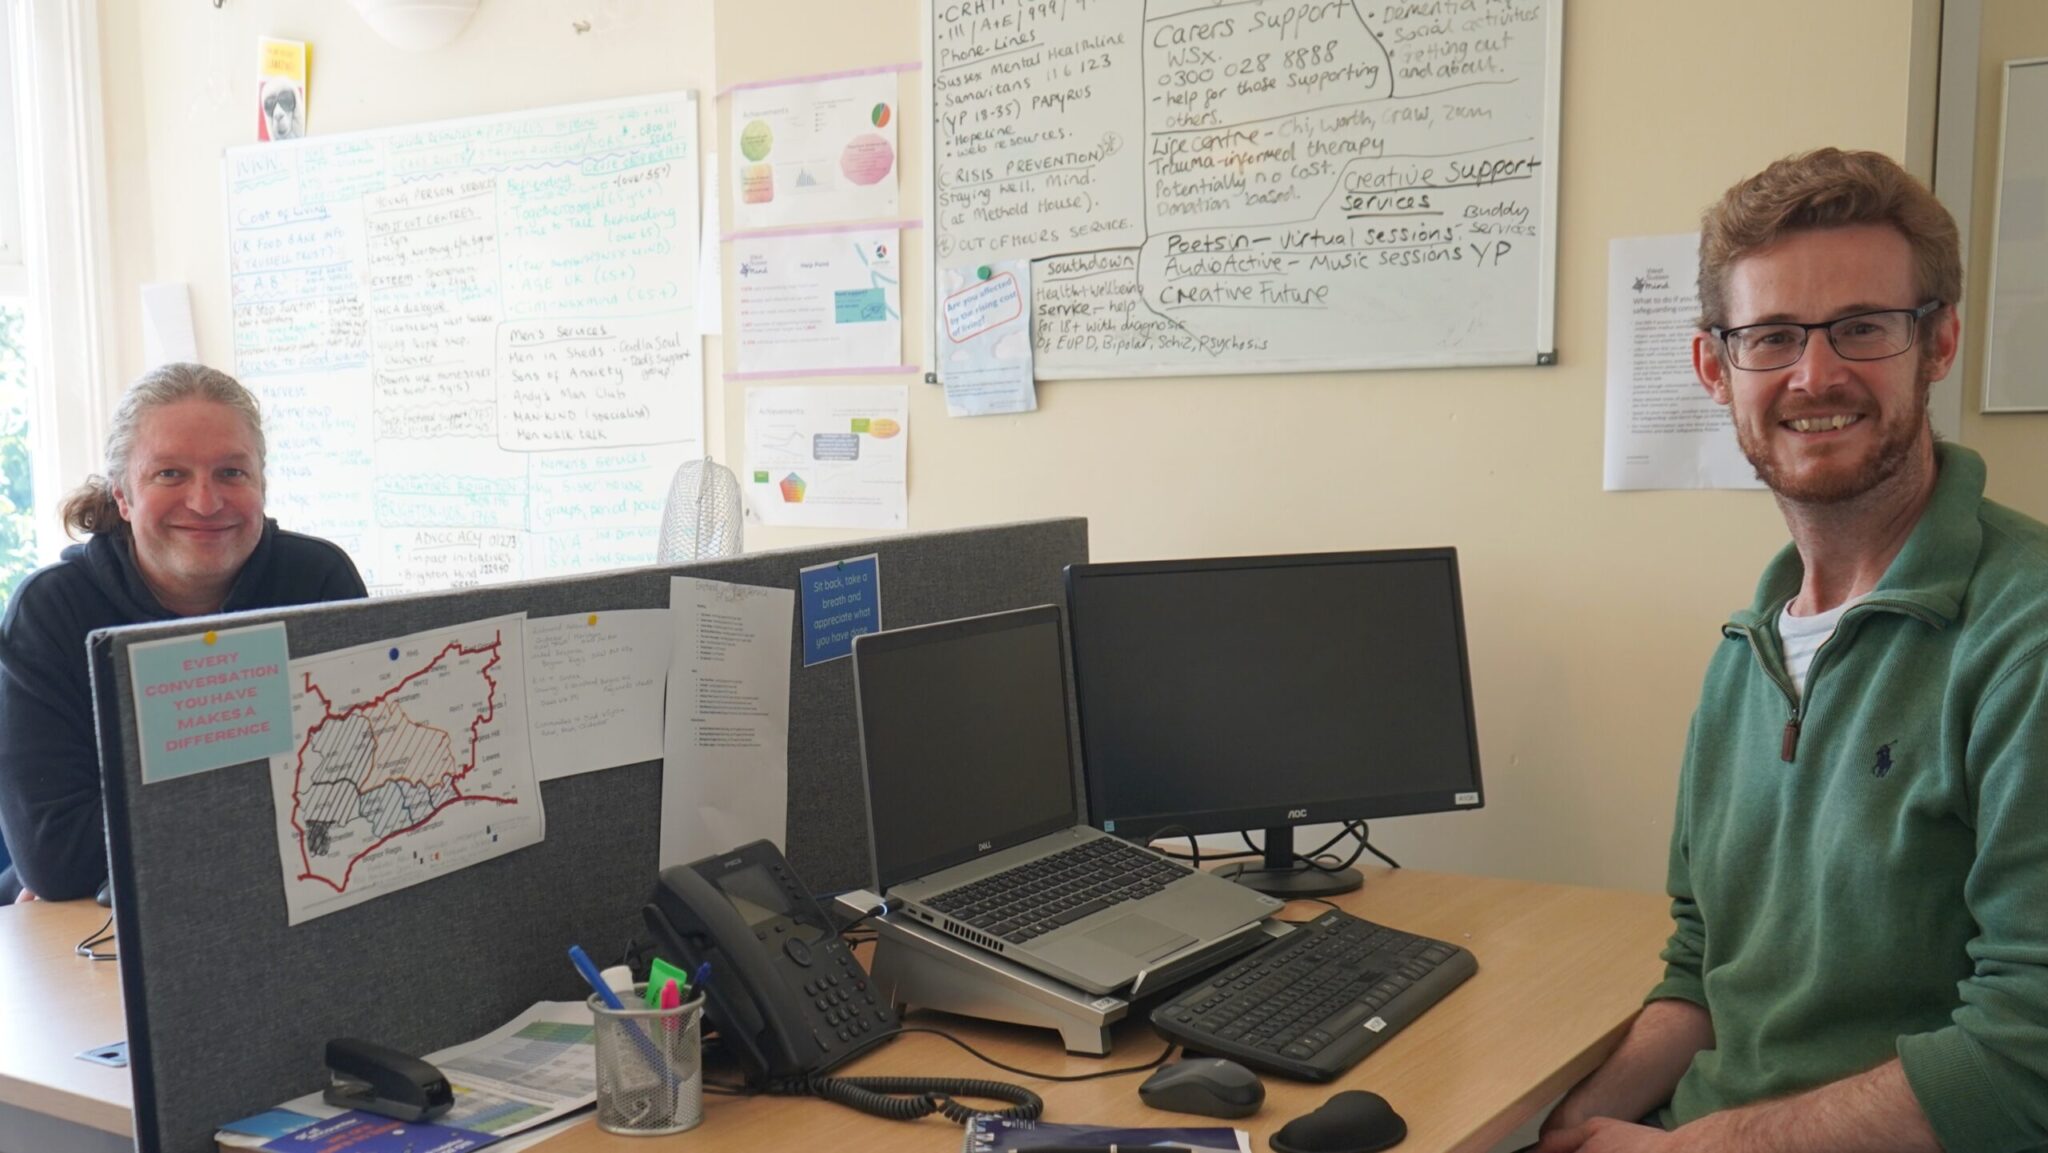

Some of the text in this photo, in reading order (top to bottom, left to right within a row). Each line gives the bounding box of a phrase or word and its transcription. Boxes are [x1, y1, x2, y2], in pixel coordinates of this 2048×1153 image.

[1153, 0, 1351, 49] Carers Support
[937, 72, 982, 90] Sussex
[991, 53, 1041, 75] Mental
[1158, 40, 1338, 87] 0300 028 8888
[1399, 62, 1433, 78] and
[945, 78, 1031, 107] Samaritans
[1081, 54, 1112, 73] 123
[1204, 87, 1227, 109] for
[1237, 76, 1276, 95] those
[1032, 88, 1091, 112] PAPYRUS
[1307, 136, 1384, 158] therapy
[1156, 172, 1247, 198] Potentially
[1255, 172, 1282, 184] no
[1345, 155, 1542, 193] Creative Support
[940, 188, 991, 207] Staying
[1157, 197, 1230, 217] Donation
[1464, 200, 1530, 224] Buddy
[1309, 253, 1369, 271] Music
[1470, 240, 1512, 267] YP
[1160, 280, 1329, 304] Creative Future
[1633, 306, 1677, 315] safeguarding
[569, 366, 624, 385] Anxiety
[813, 573, 868, 592] Sit back, take a
[822, 590, 861, 609] breath and
[813, 607, 871, 629] appreciate what
[816, 635, 830, 649] you
[831, 631, 849, 643] have
[182, 652, 239, 672] EVERY
[144, 664, 279, 697] CONVERSATION
[174, 687, 258, 711] YOU HAVE
[177, 706, 256, 731] MAKES A
[165, 721, 271, 752] DIFFERENCE
[1287, 808, 1308, 819] AOC
[978, 841, 992, 852] DELL
